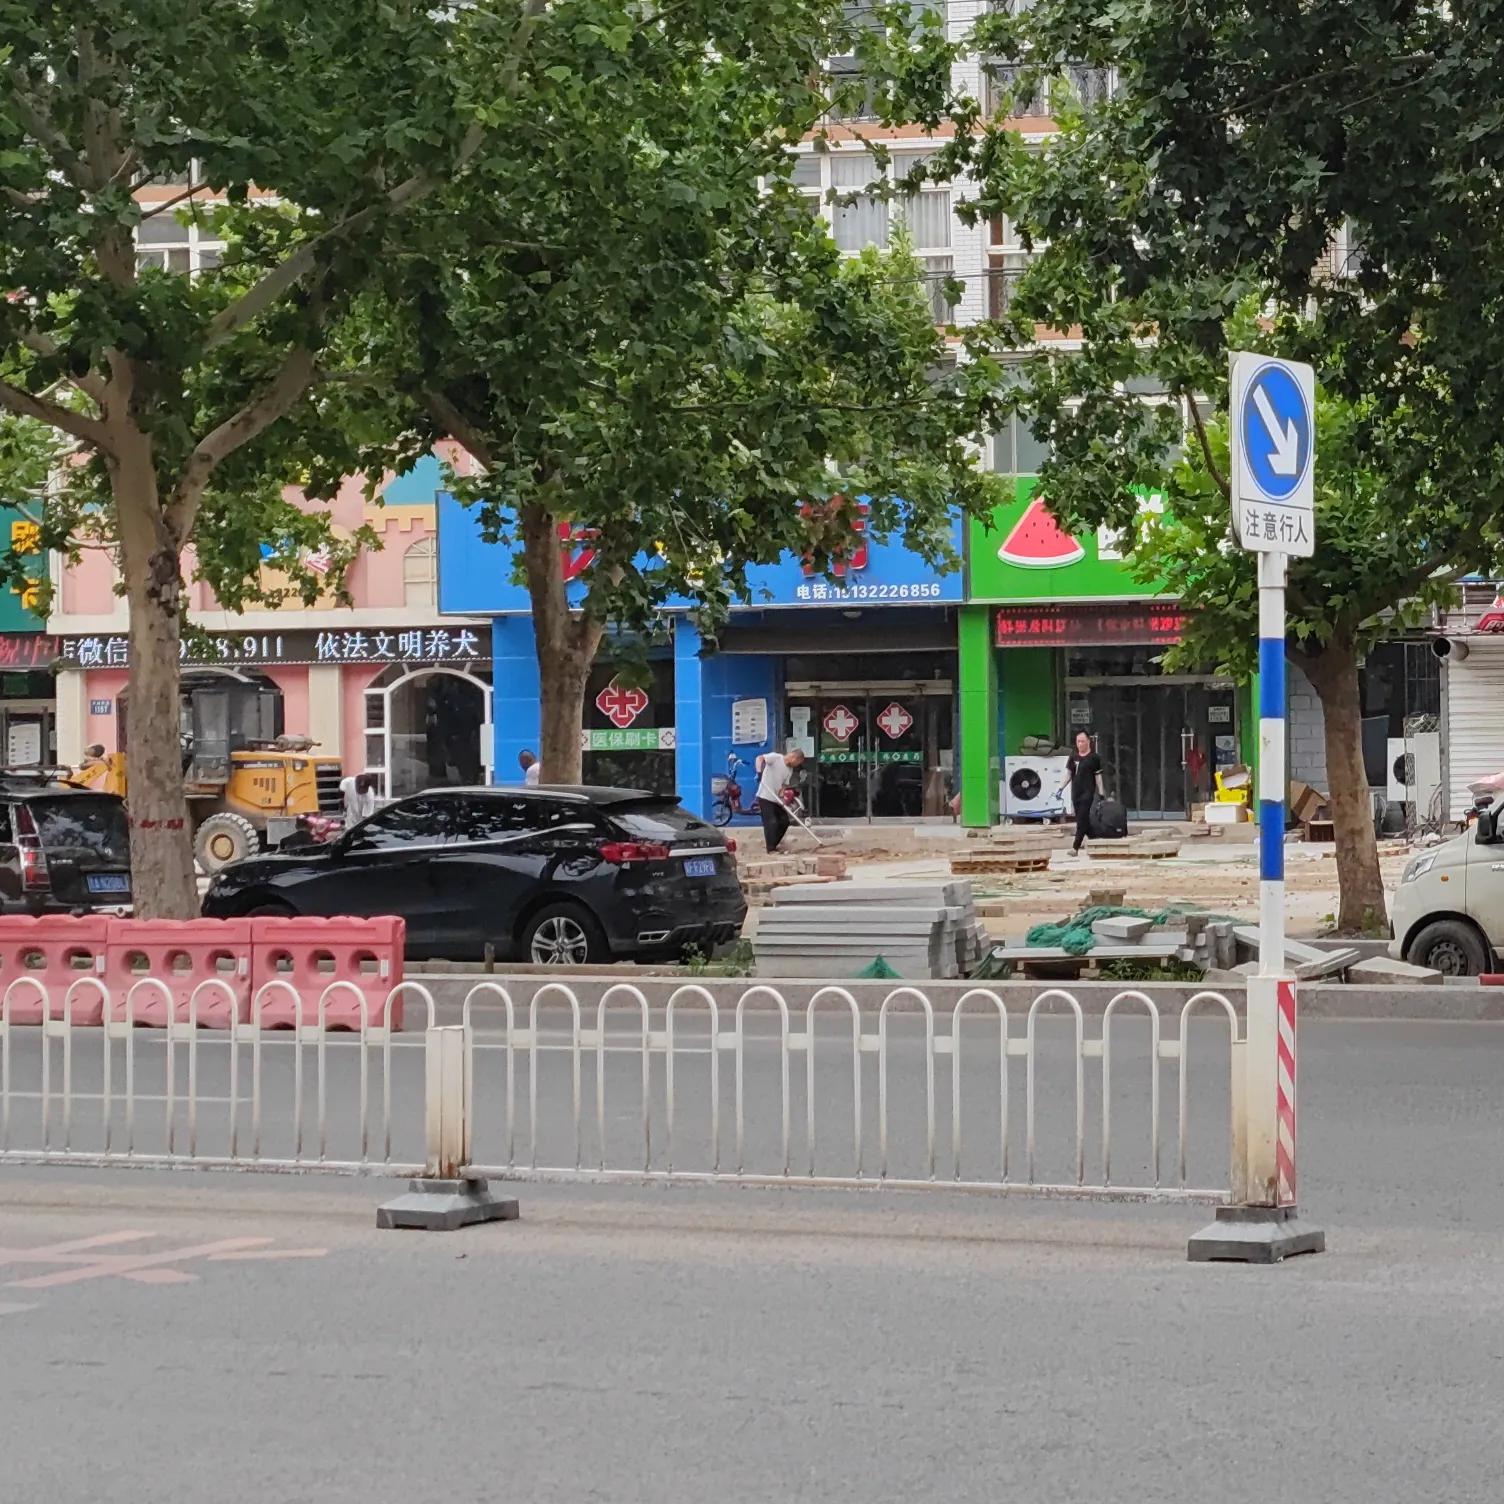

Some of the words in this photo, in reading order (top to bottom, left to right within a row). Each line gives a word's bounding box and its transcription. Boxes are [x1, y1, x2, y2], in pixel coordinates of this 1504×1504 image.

[1245, 509, 1309, 544] 注意行人
[315, 629, 479, 659] 依法文明养犬
[591, 730, 659, 747] 医保刷卡
